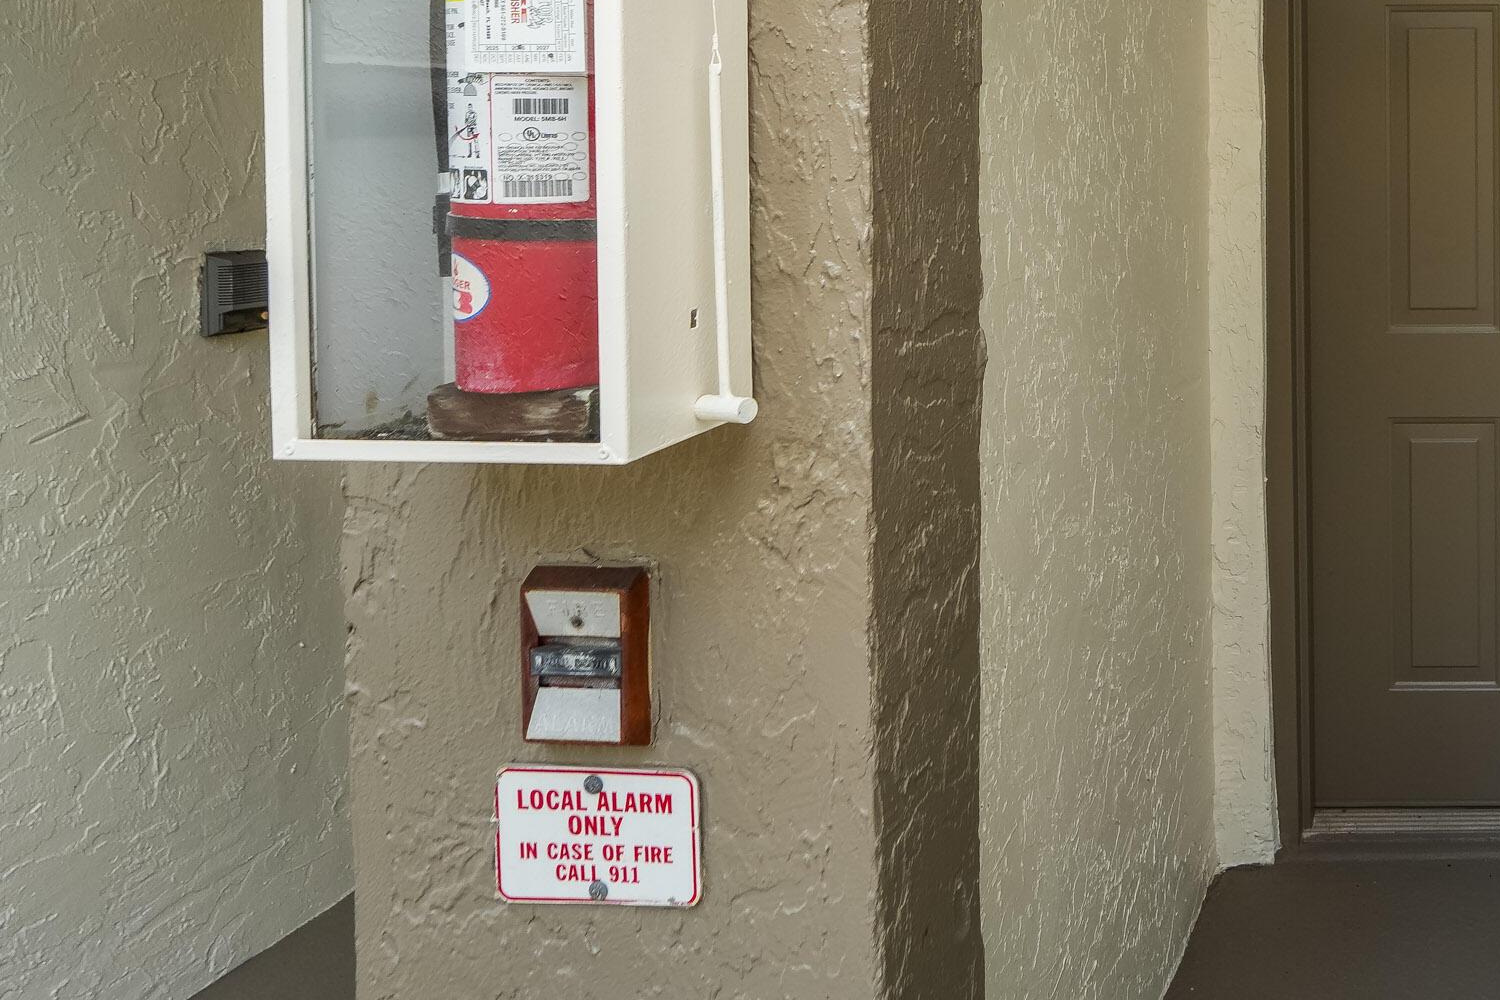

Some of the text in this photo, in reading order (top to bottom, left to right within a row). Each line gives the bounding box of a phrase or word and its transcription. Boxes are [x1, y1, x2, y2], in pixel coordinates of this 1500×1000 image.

[517, 789, 673, 814] LOCAL ALARM
[568, 815, 624, 836] ONLY
[520, 842, 674, 864] IN CASE OF FIRE
[555, 864, 640, 884] CALL 911
